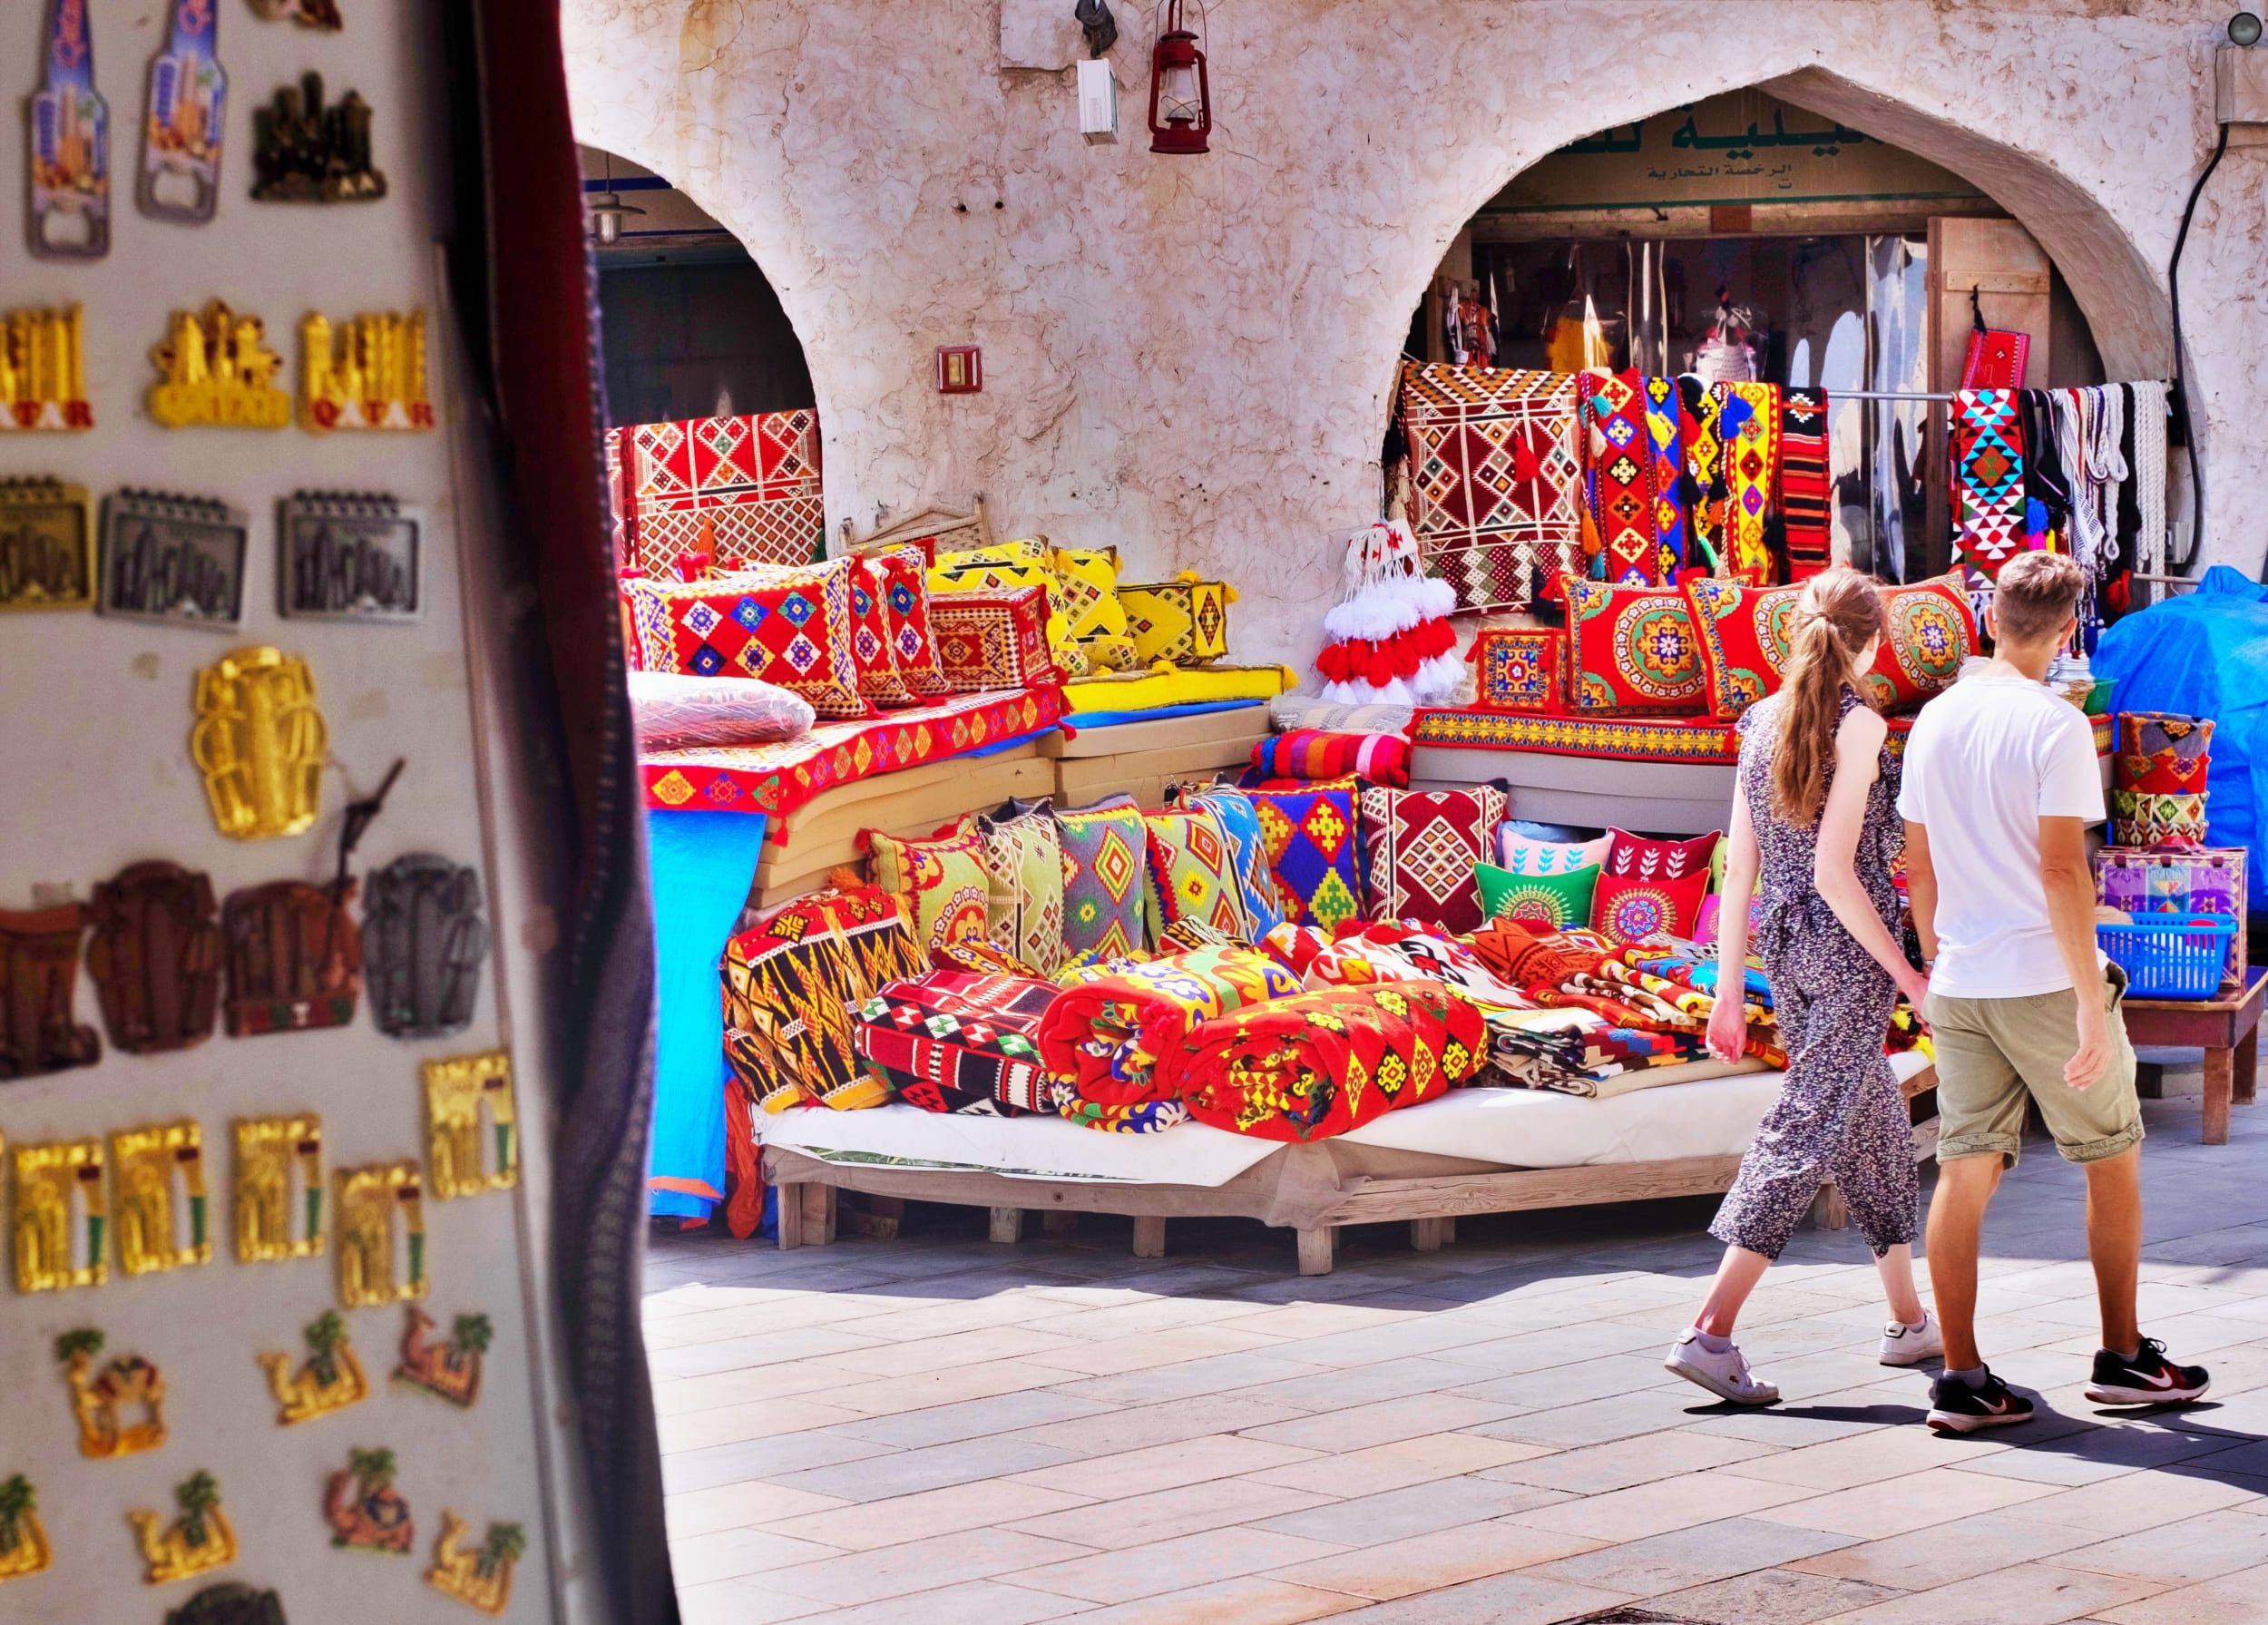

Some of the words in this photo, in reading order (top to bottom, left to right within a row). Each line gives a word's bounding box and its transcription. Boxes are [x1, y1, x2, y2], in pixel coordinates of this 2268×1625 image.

[1724, 163, 1792, 177] الرخصة
[0, 400, 93, 426] ATAR
[313, 400, 435, 427] QATAR
